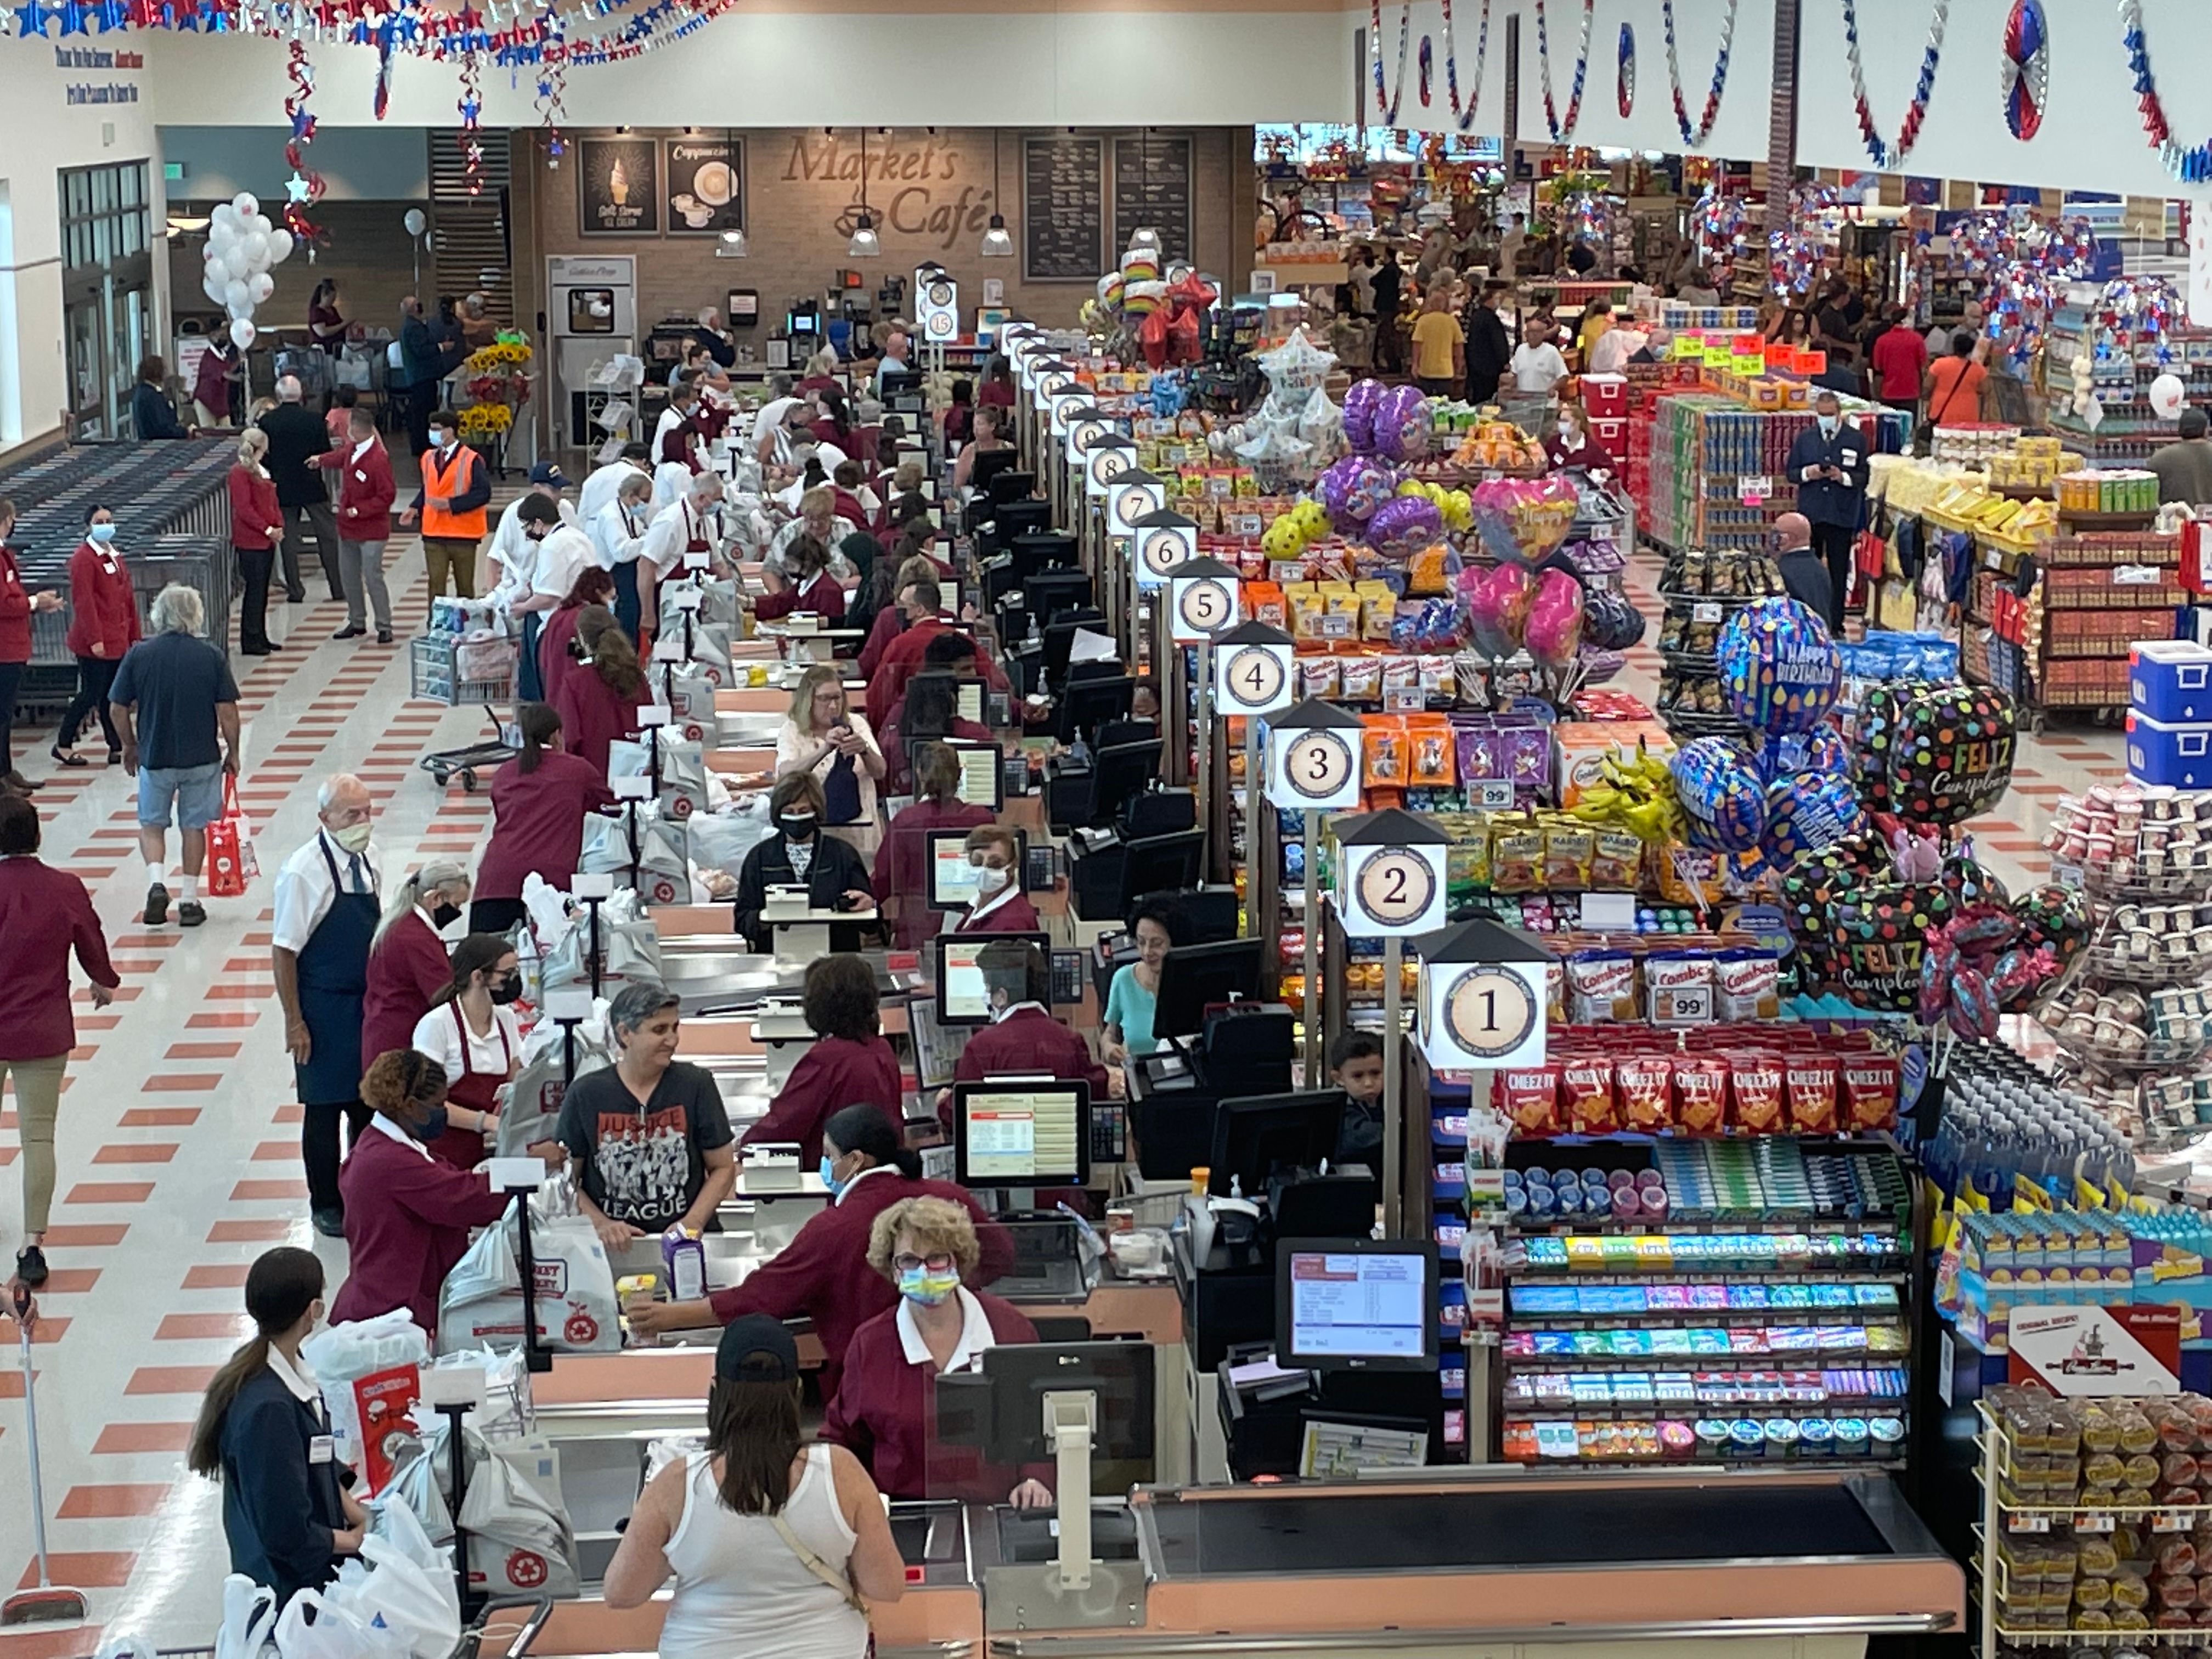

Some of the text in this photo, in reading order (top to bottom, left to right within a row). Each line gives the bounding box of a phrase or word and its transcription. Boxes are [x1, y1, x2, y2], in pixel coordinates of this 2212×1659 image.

[781, 133, 959, 181] Market's
[888, 186, 992, 250] Café
[935, 317, 949, 330] 15
[1105, 459, 1117, 479] 8
[1131, 497, 1144, 518] 7
[1158, 540, 1173, 563] 6
[1197, 594, 1212, 618] 5
[1787, 642, 1829, 664] HAPPY
[1245, 662, 1265, 691] 4
[1776, 662, 1833, 685] BIRTHDAY
[1308, 747, 1329, 780] 3
[1954, 736, 2011, 775] FELIZ
[1383, 867, 1407, 904] 2
[1851, 940, 1922, 973] FELIZ
[1582, 964, 1632, 989] Combos
[1726, 960, 1778, 989] Combos
[1479, 989, 1501, 1031] 1
[602, 1196, 687, 1221] LEAGUE
